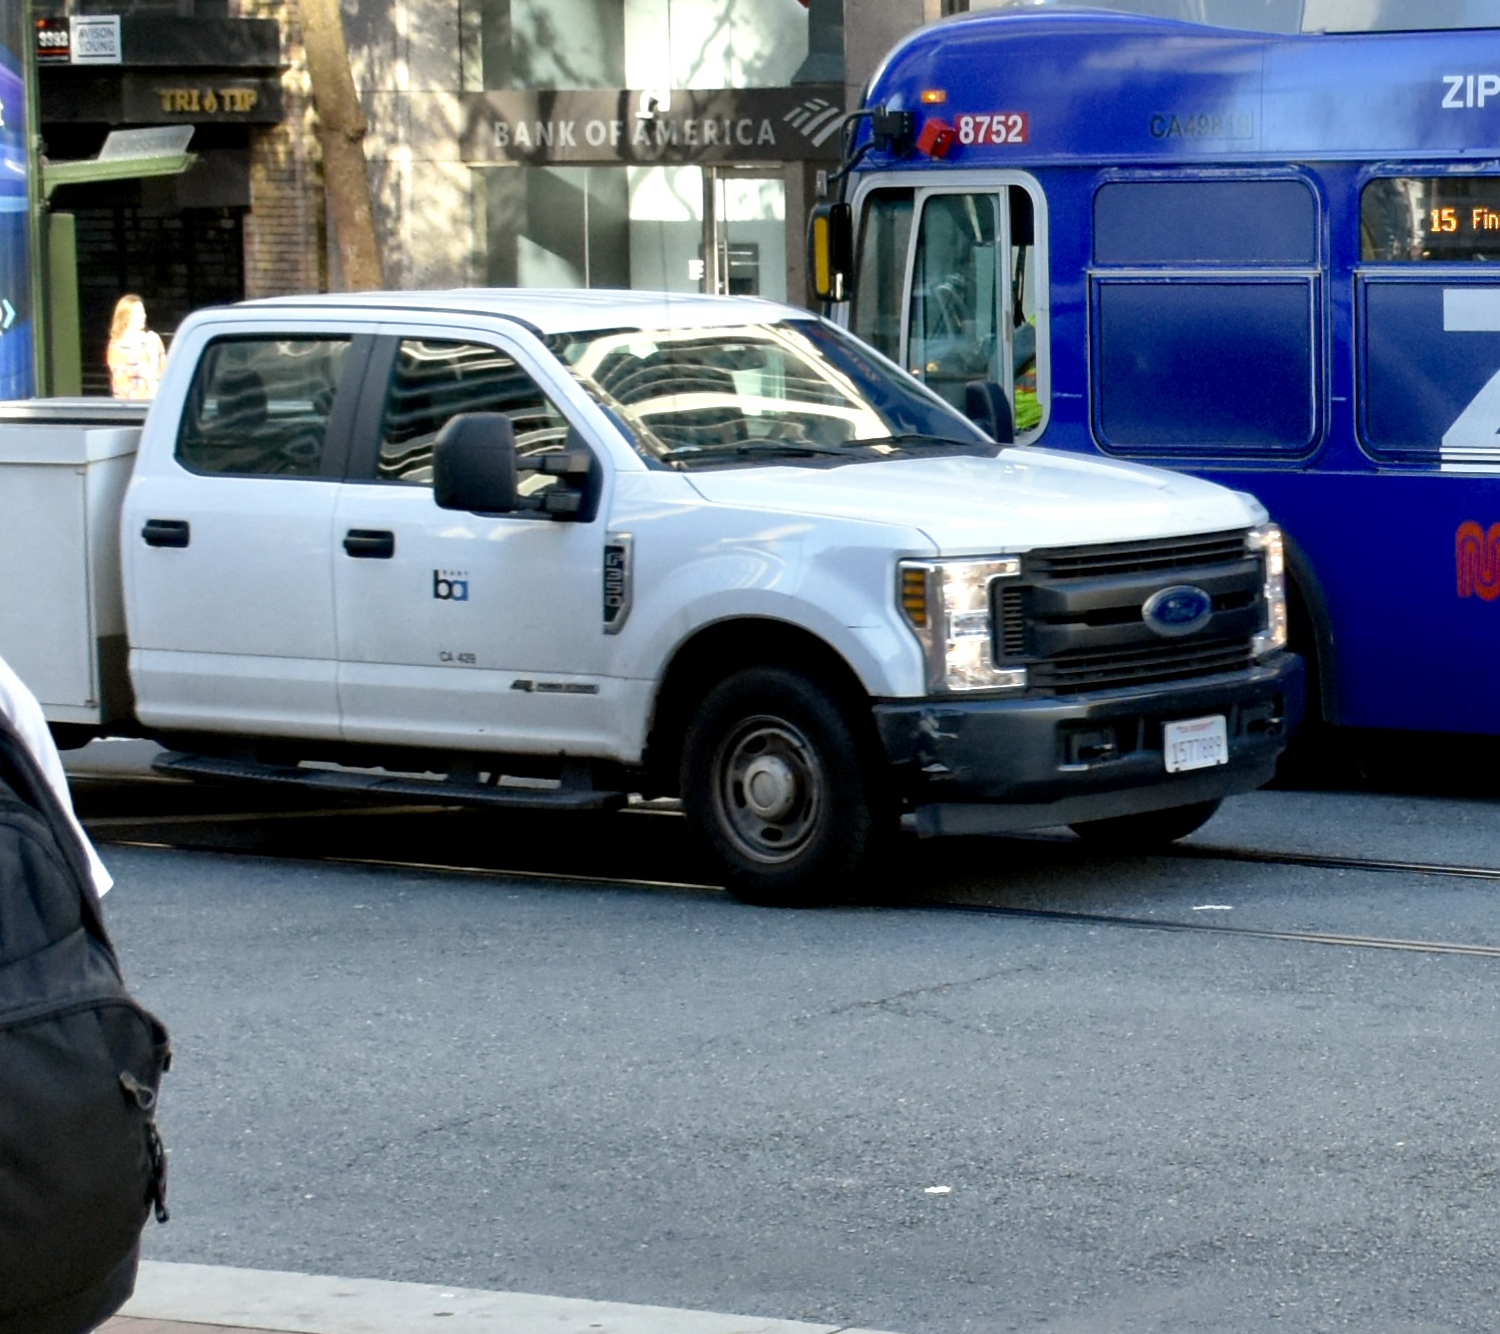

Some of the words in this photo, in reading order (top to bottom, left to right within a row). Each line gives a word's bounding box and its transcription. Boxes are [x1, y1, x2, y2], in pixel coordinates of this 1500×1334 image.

[78, 27, 115, 39] AVISON
[77, 39, 116, 52] YOUNG
[160, 88, 200, 112] TRI
[220, 88, 258, 112] TIP
[494, 119, 577, 147] BANK
[584, 119, 623, 147] OF
[631, 118, 777, 146] AMERICA
[958, 114, 1024, 145] 8752
[1430, 208, 1458, 232] 15
